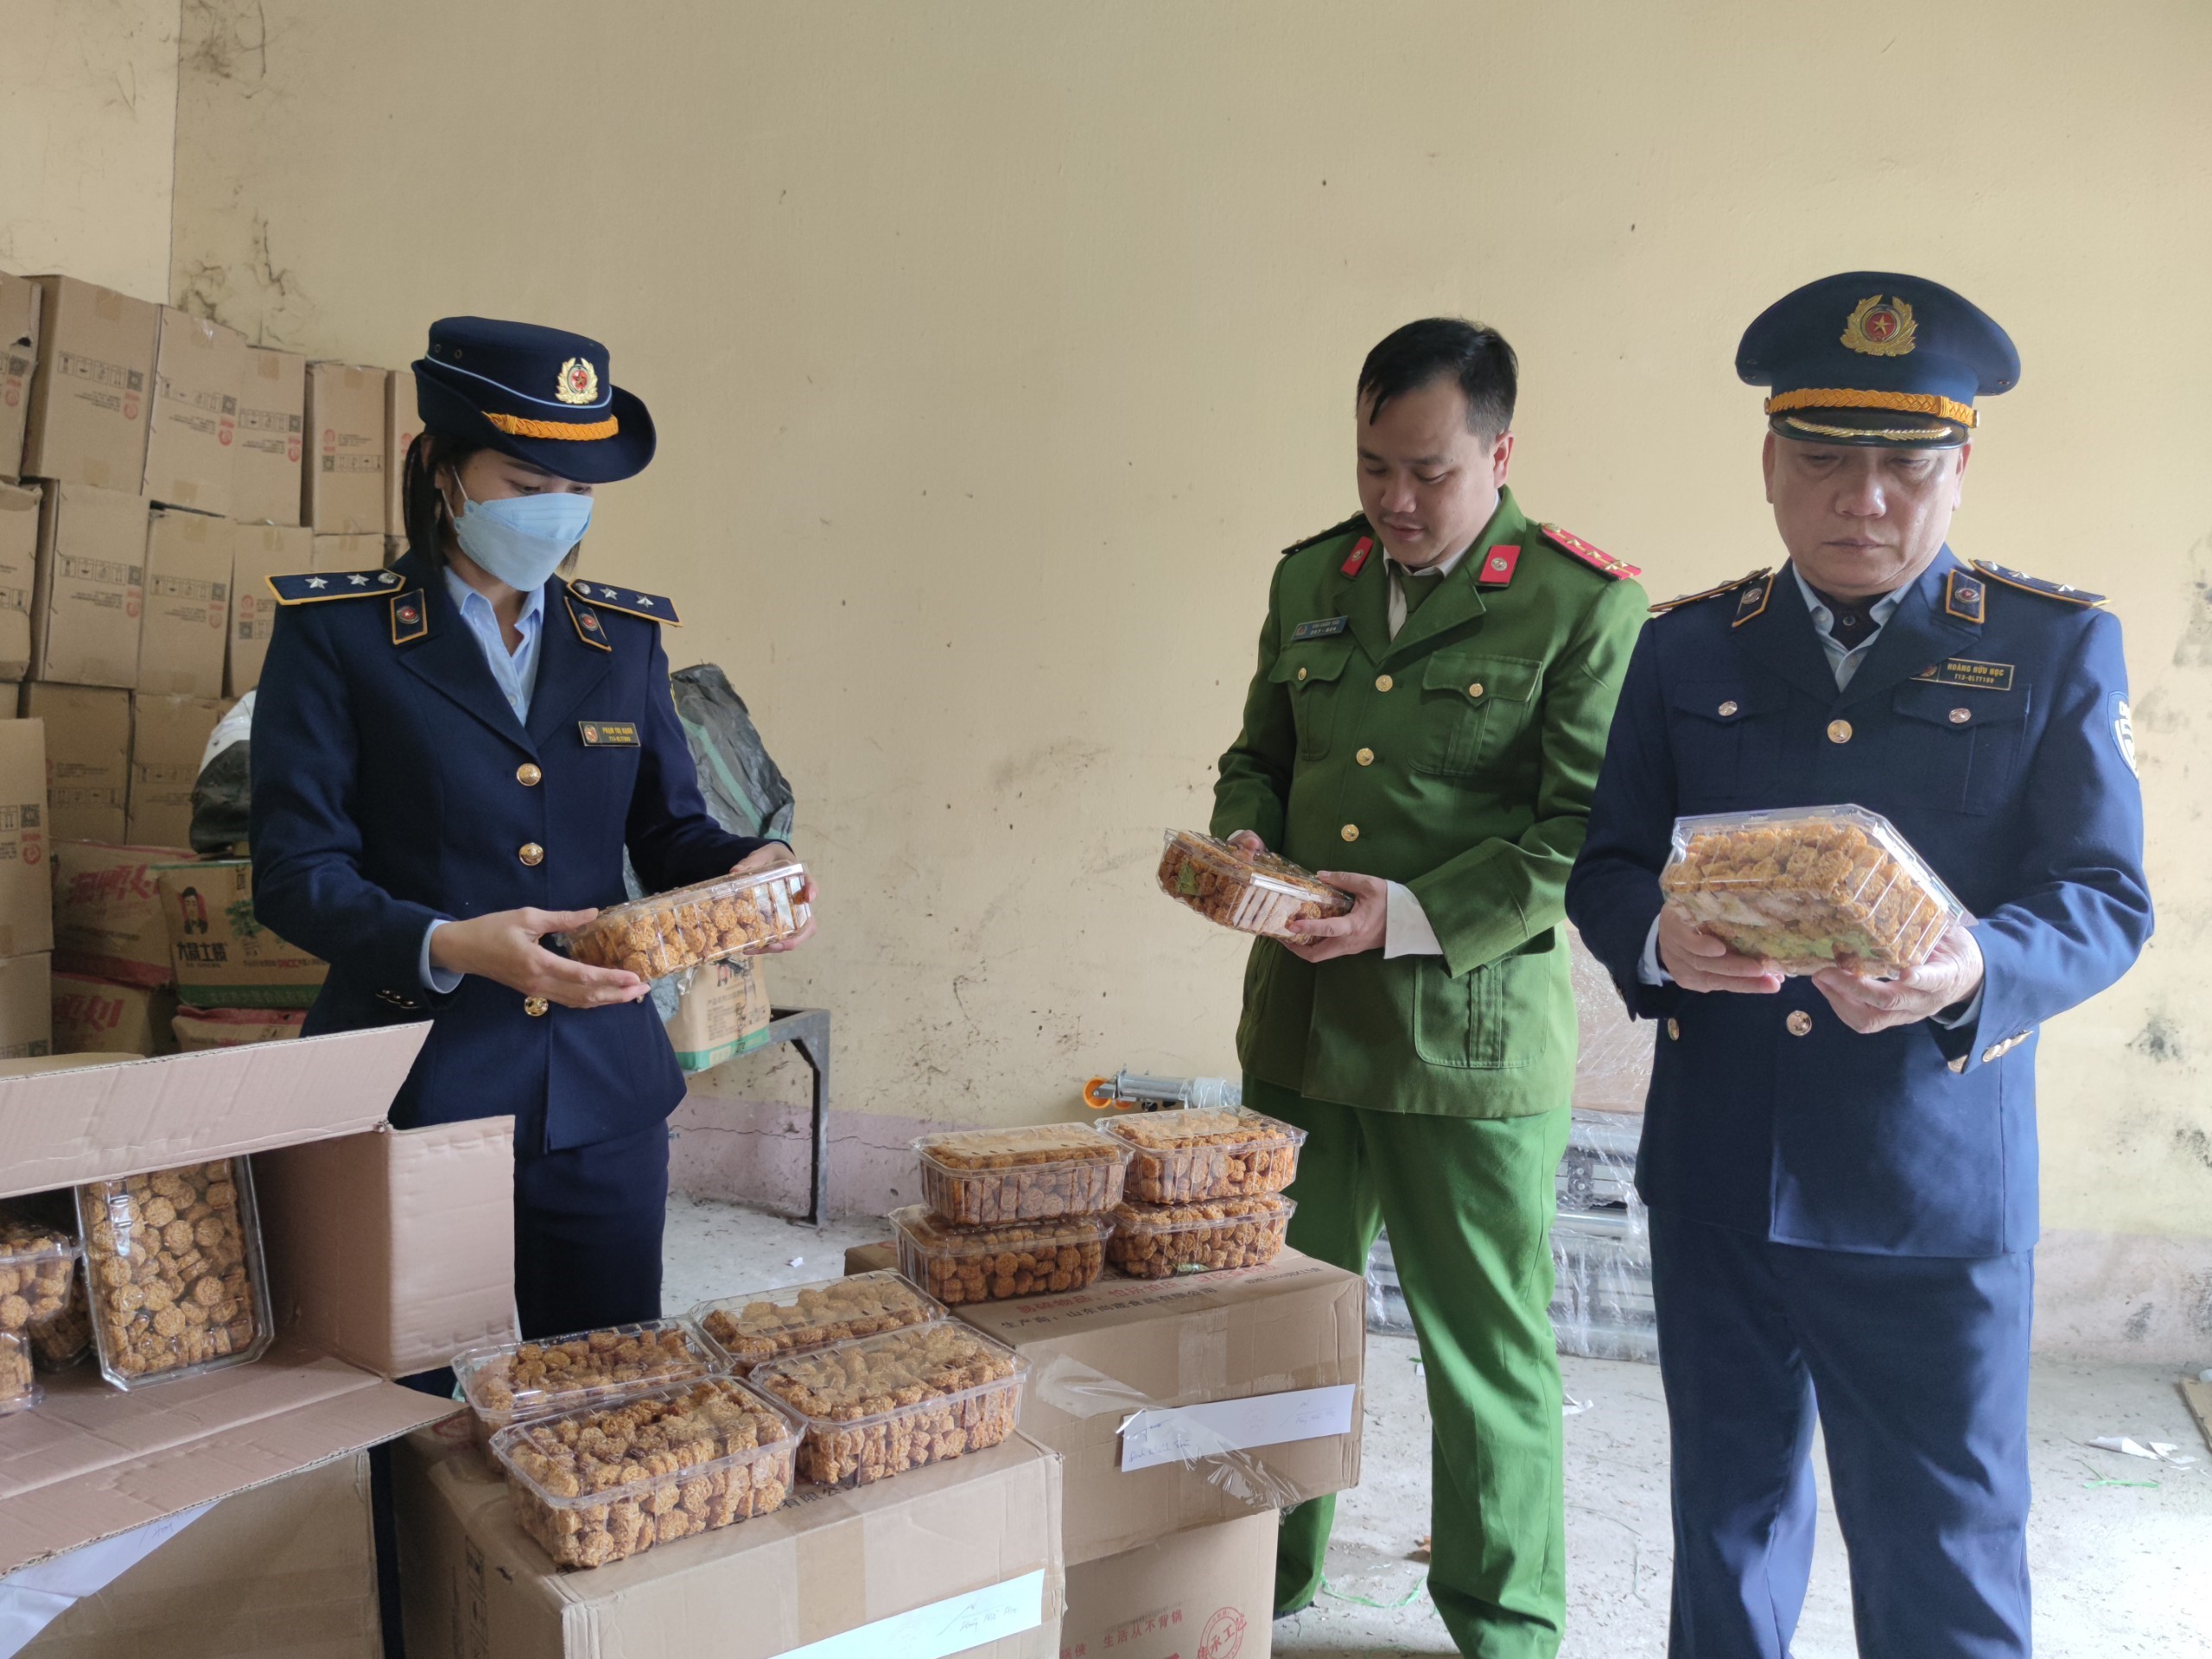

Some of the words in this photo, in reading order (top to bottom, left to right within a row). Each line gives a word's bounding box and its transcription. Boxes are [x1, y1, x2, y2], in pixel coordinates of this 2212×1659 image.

[1947, 663, 1971, 672] HOÀNG
[1974, 665, 1987, 675] HỮU
[1989, 668, 2005, 677] HỌC
[1103, 1609, 1183, 1649] 生活从不背锅
